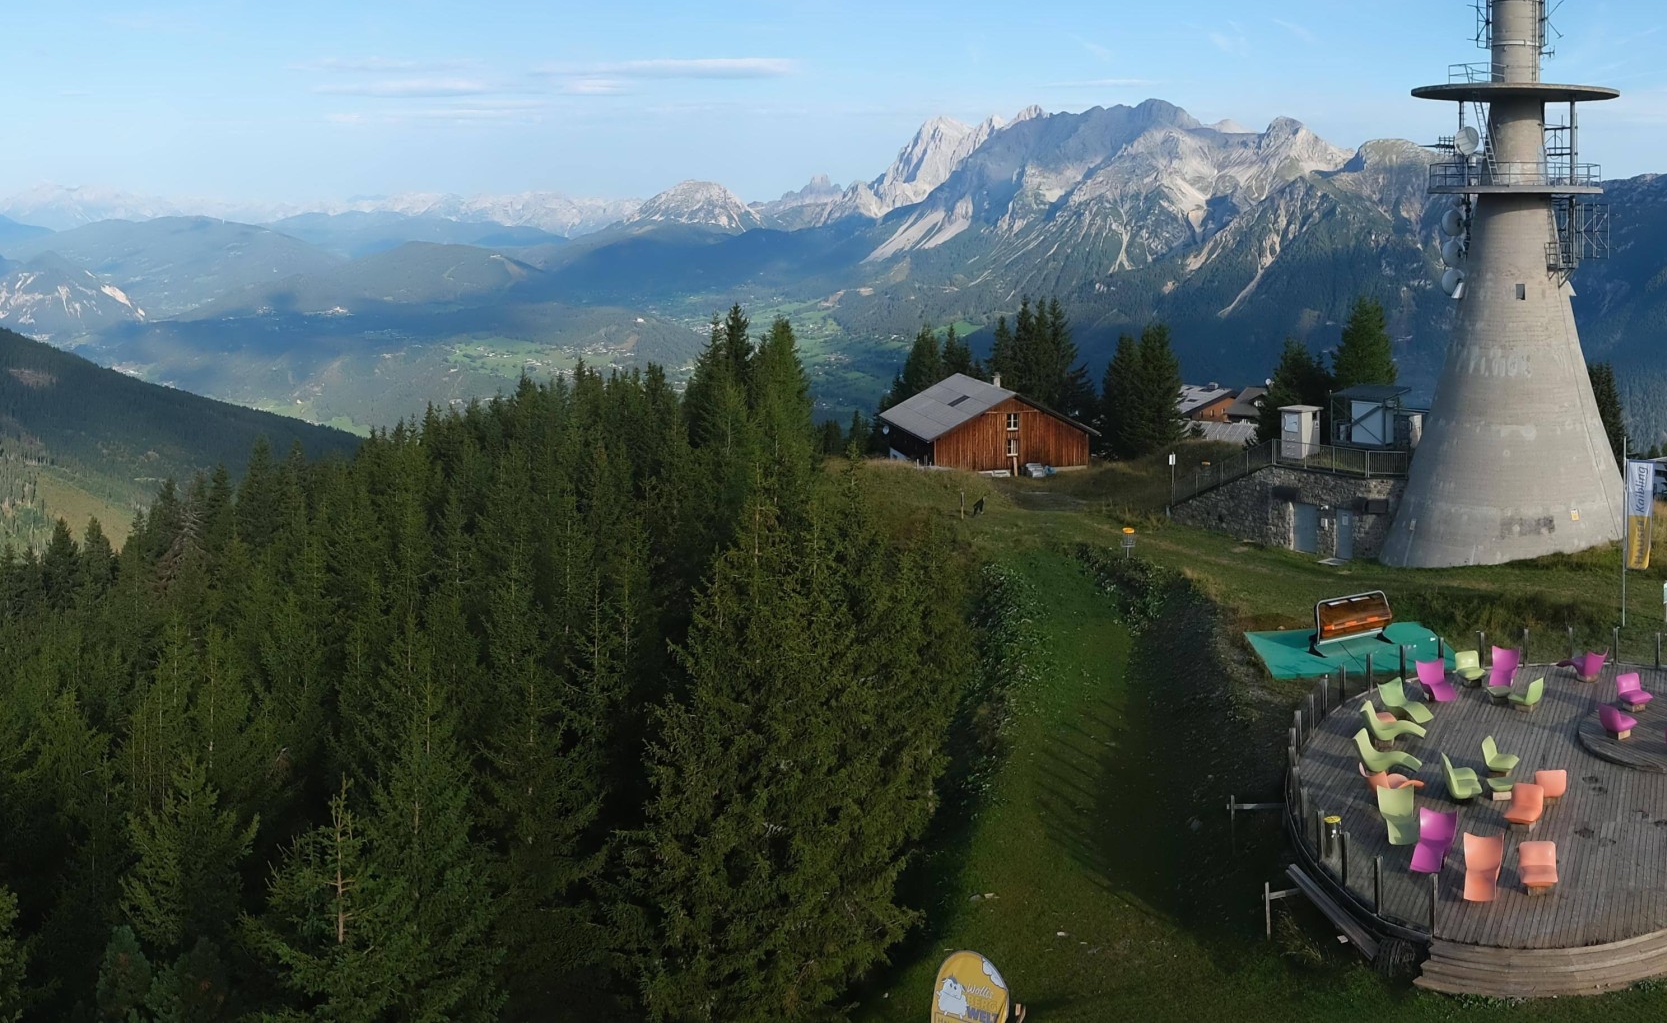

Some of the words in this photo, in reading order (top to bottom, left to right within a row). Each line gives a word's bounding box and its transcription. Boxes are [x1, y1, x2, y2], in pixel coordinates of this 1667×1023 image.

[1635, 466, 1648, 513] Kaibling
[967, 983, 993, 999] Wollis
[968, 996, 998, 1012] BERG
